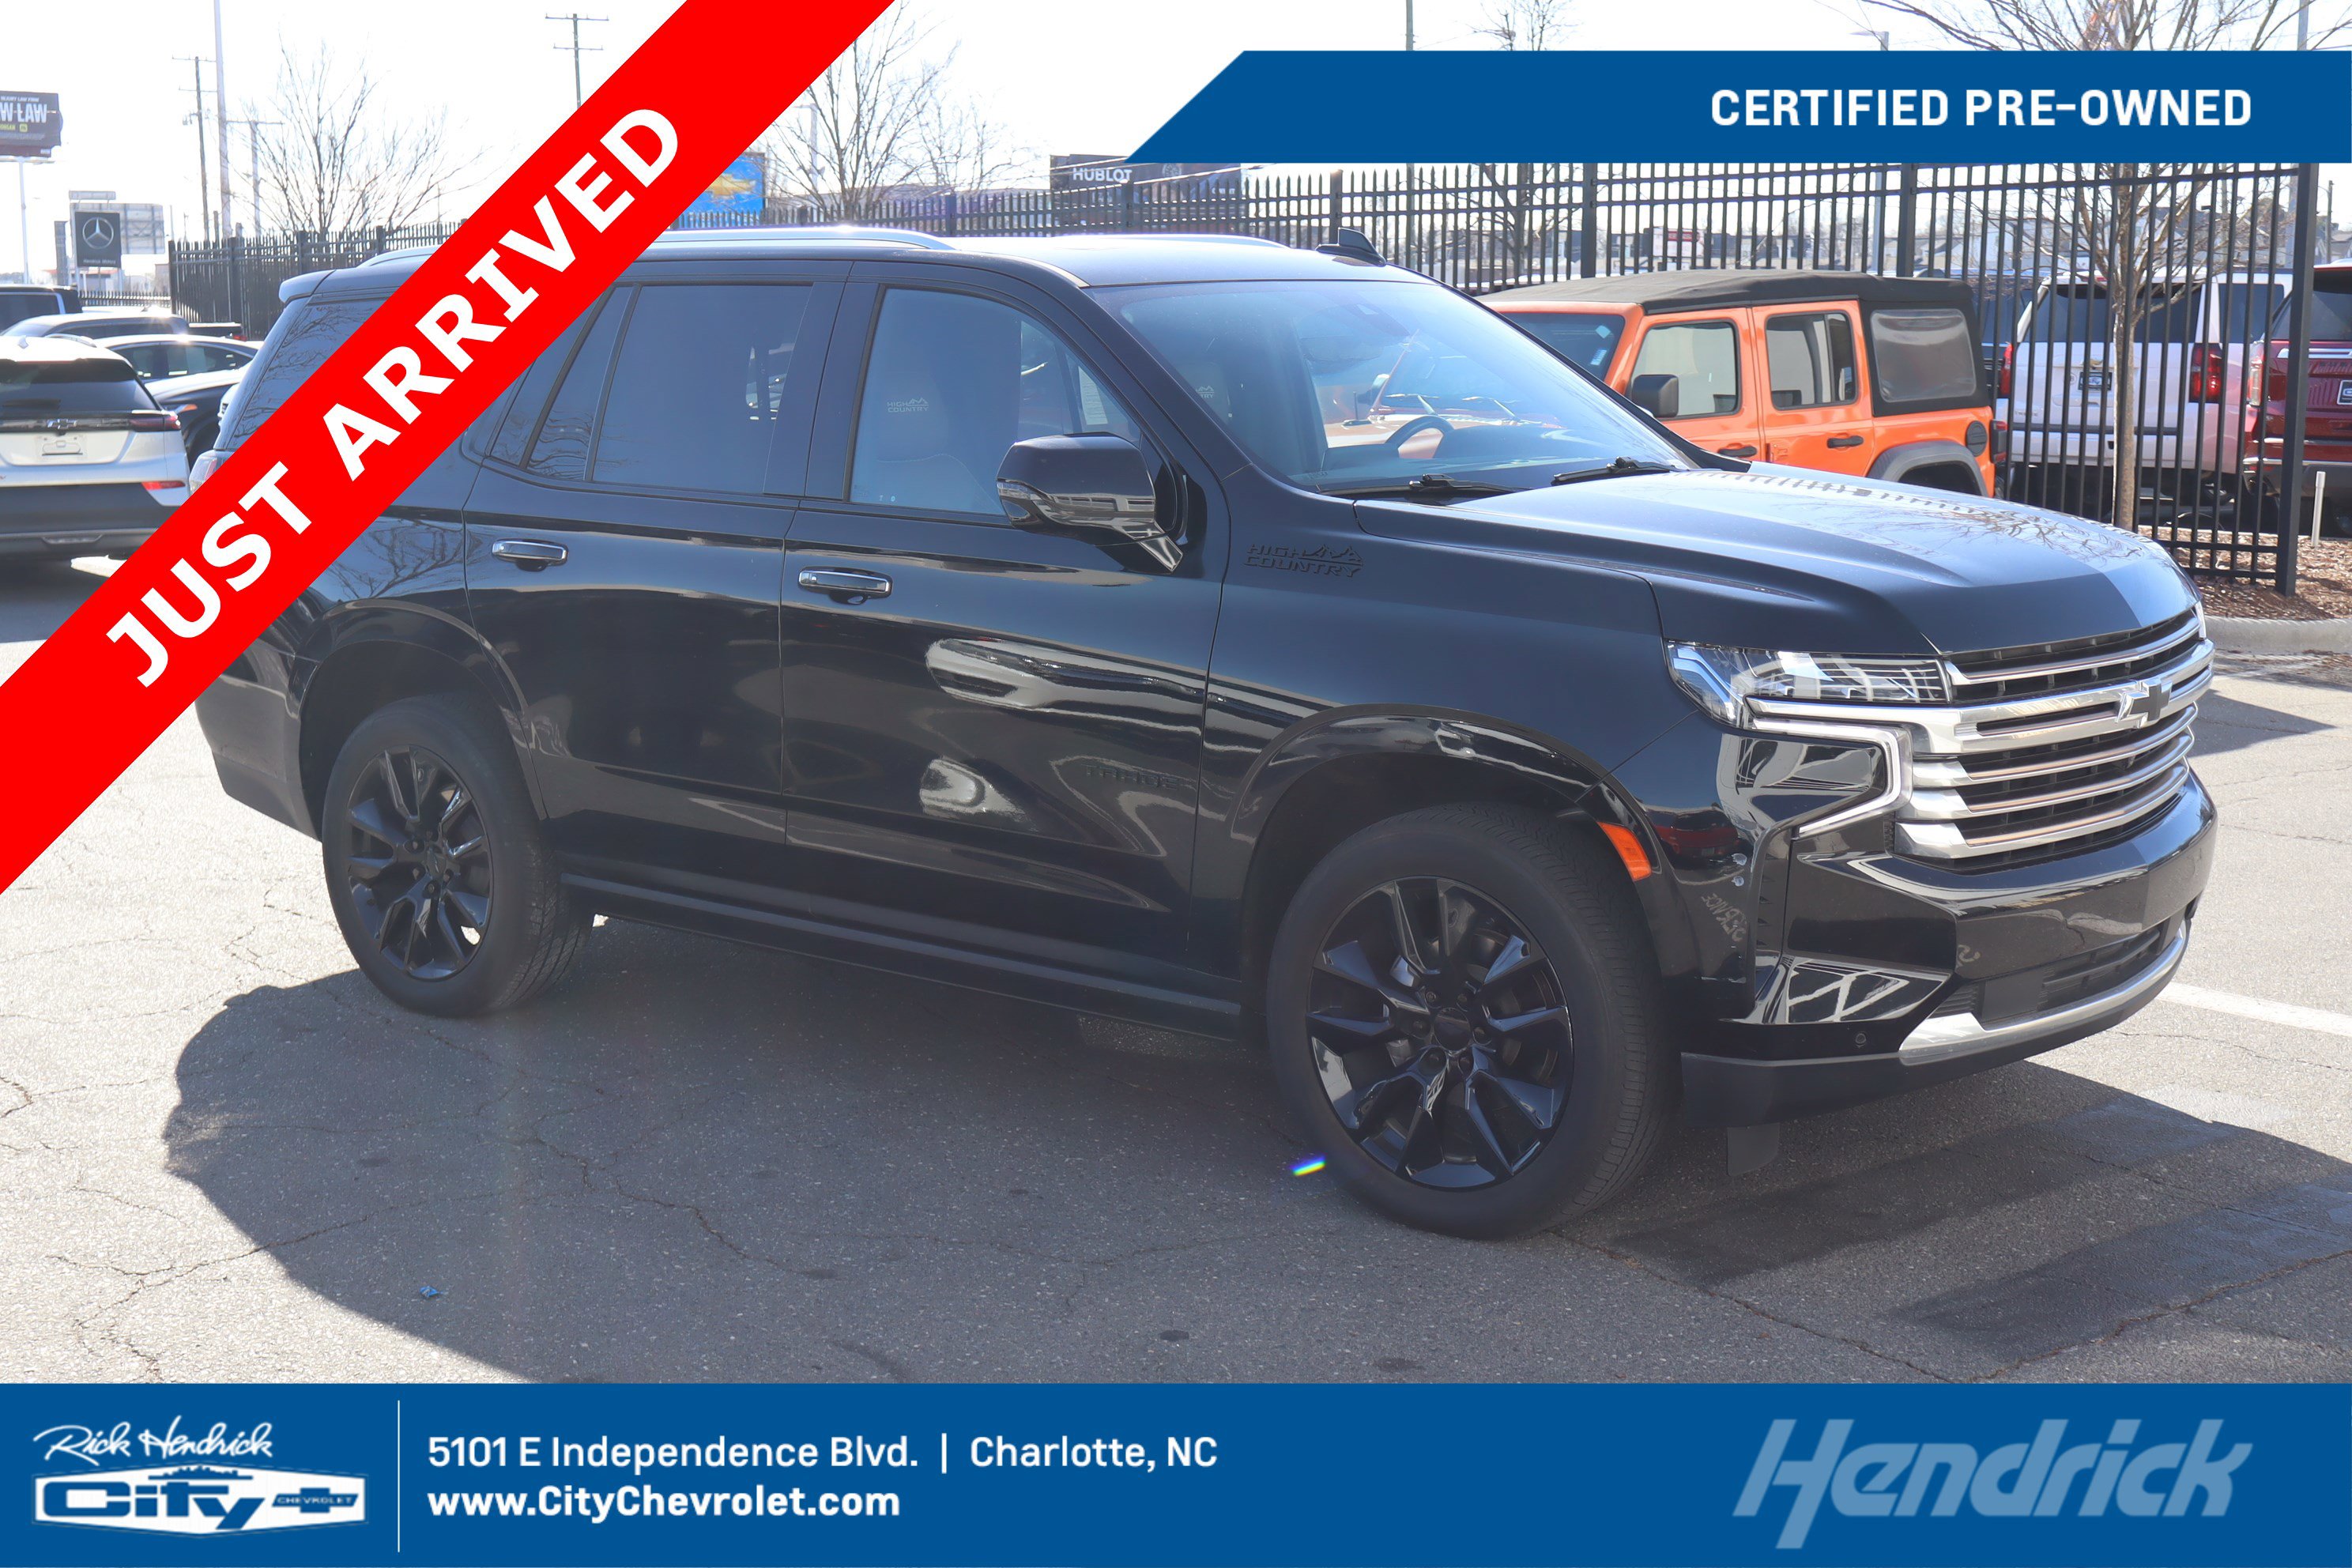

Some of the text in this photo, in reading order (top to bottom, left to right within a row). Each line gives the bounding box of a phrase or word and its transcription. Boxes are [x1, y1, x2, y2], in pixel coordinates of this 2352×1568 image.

[17, 103, 47, 123] LAW
[1072, 168, 1133, 183] HUBLOT
[1246, 544, 1307, 559] HIGH
[1243, 556, 1363, 578] COUNTRY
